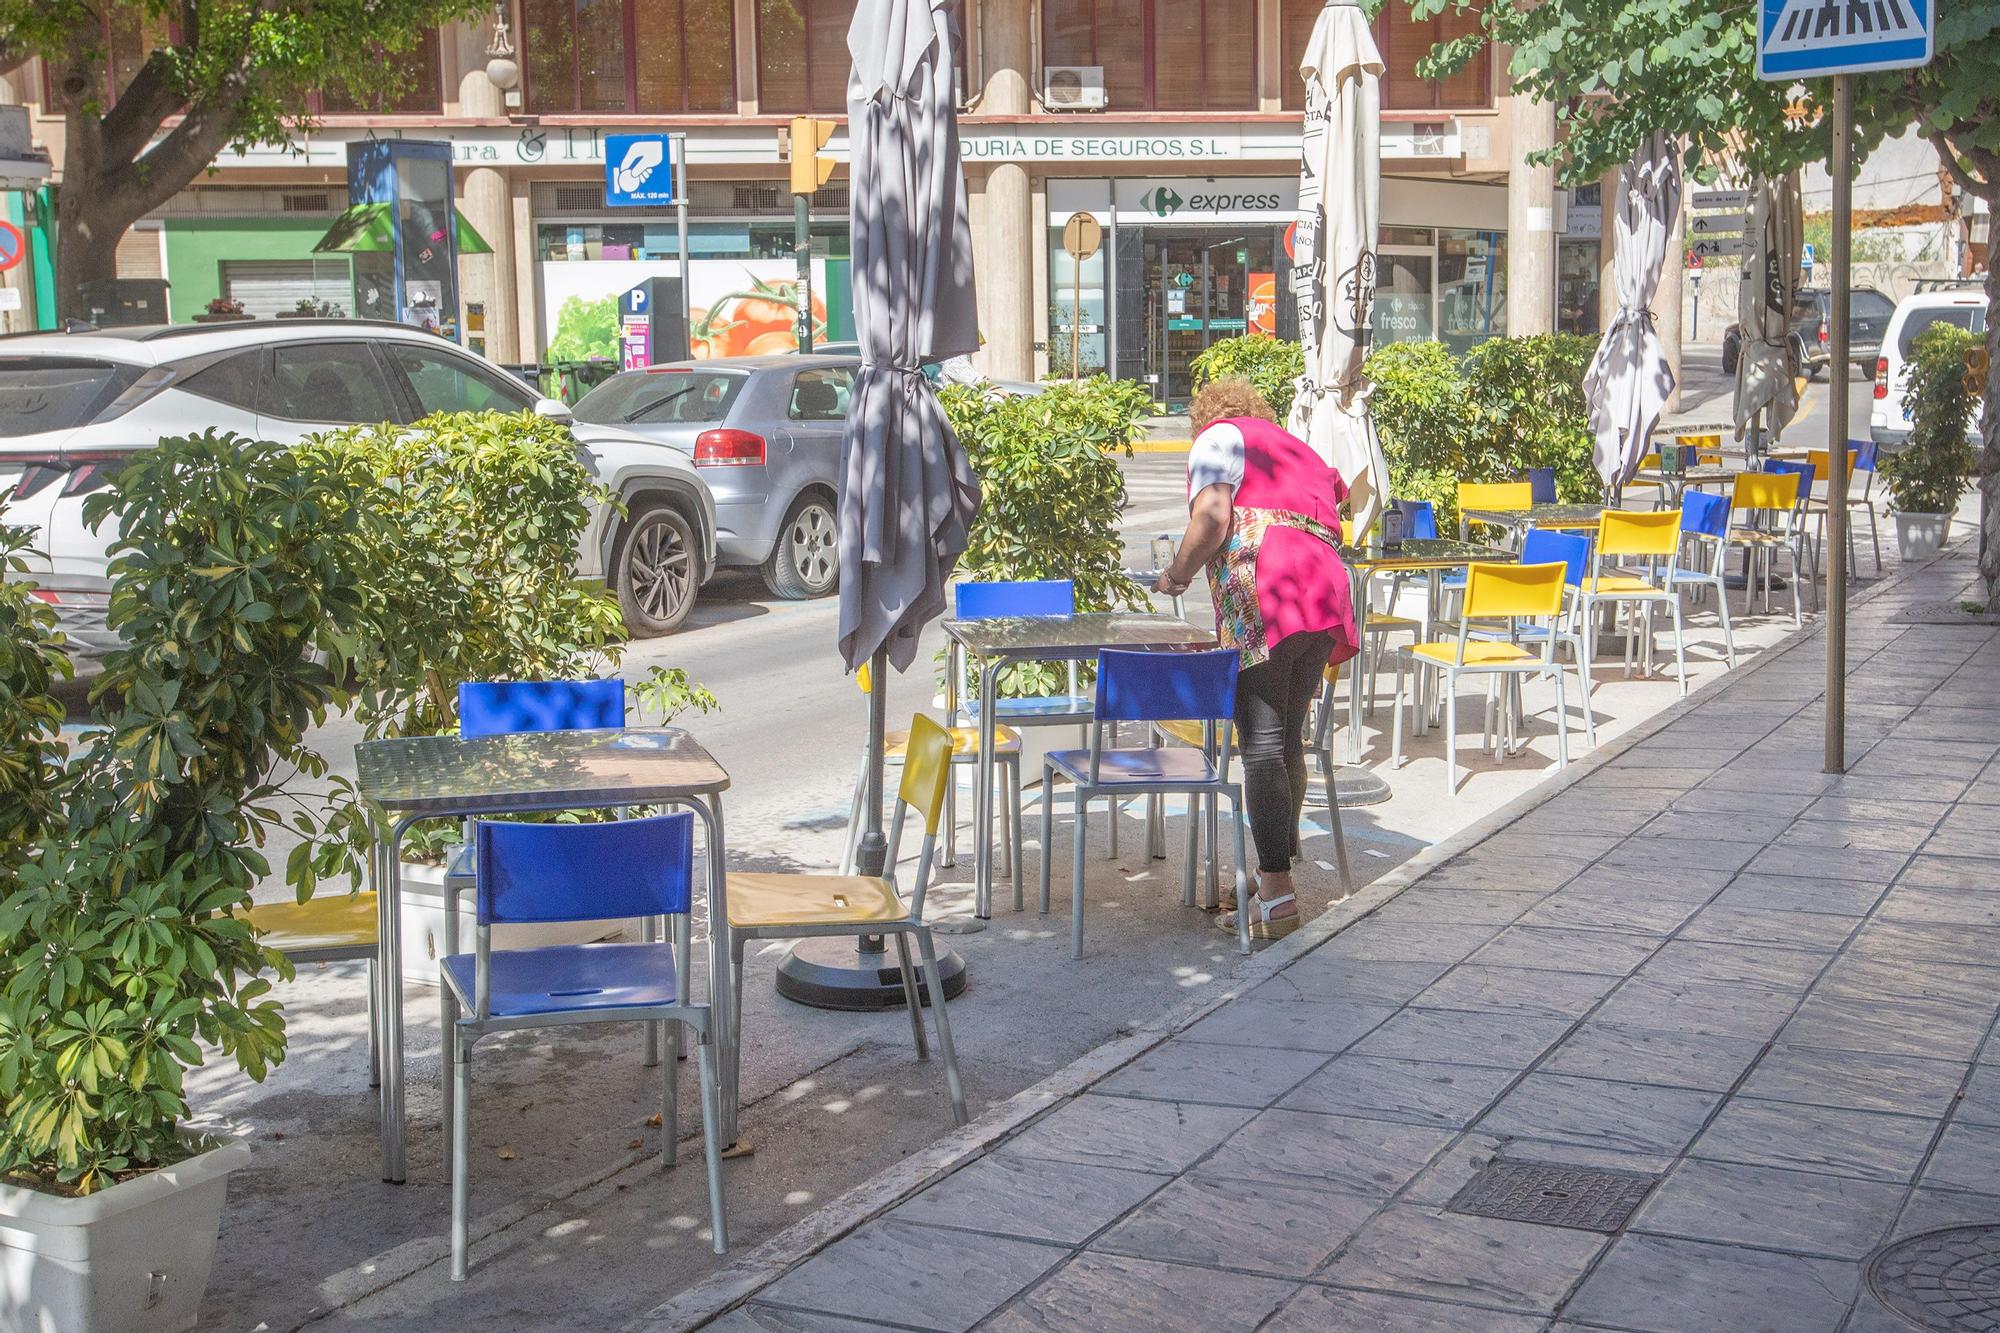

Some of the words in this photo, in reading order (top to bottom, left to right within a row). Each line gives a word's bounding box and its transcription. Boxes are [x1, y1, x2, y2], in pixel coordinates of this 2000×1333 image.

[1035, 140, 1064, 156] DE
[1190, 193, 1281, 215] express
[631, 290, 646, 311] P
[1380, 311, 1417, 330] fresco
